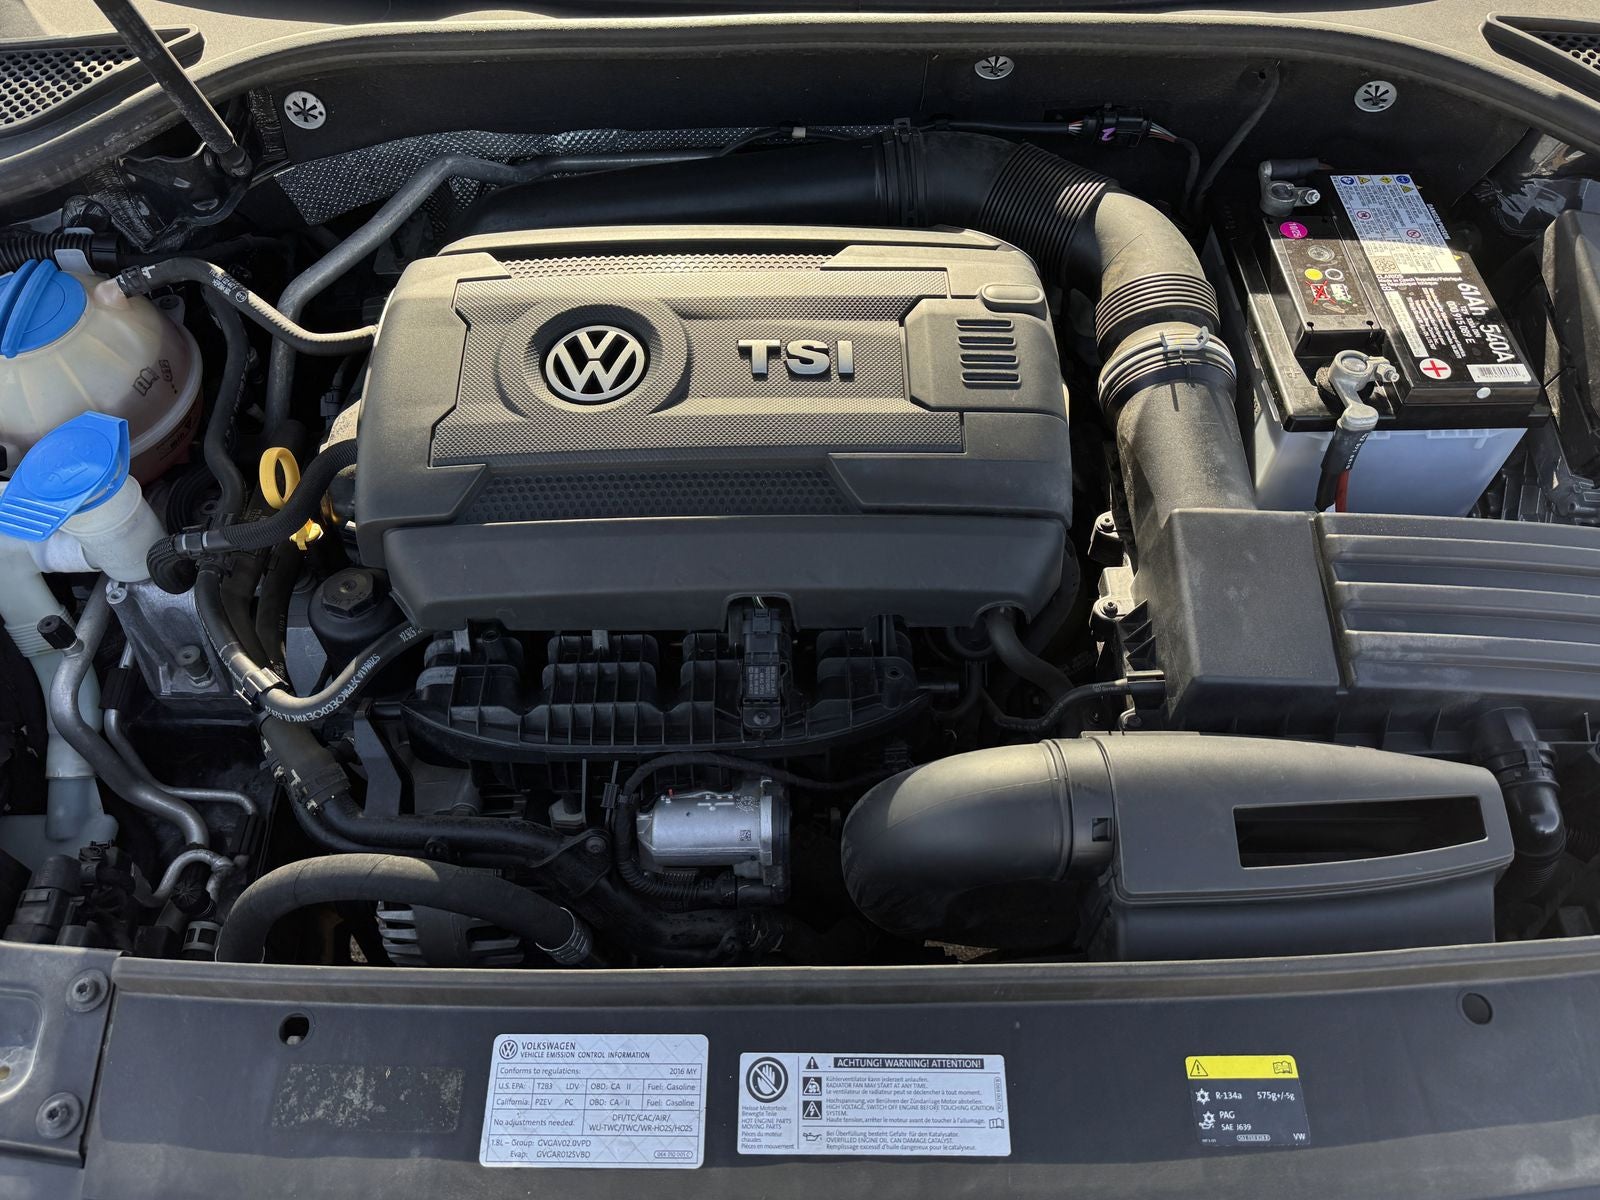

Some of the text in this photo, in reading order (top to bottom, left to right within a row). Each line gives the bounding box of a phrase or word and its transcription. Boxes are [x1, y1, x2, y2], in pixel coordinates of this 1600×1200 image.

[1452, 313, 1465, 324] 915
[1458, 283, 1489, 316] 61Ah
[1480, 324, 1515, 362] 540A
[737, 340, 855, 375] TSI
[522, 1042, 576, 1050] VOLKSWAGEN
[837, 1058, 981, 1068] ACHTUNG! WARNING! ATTENTION!
[542, 1068, 580, 1076] regulations:
[612, 1114, 671, 1122] DFI/TC/CAC/AIR/
[1219, 1111, 1235, 1119] PAG
[505, 1119, 546, 1127] adjustments
[512, 1140, 534, 1148] Group:
[510, 1151, 528, 1159] Evap:
